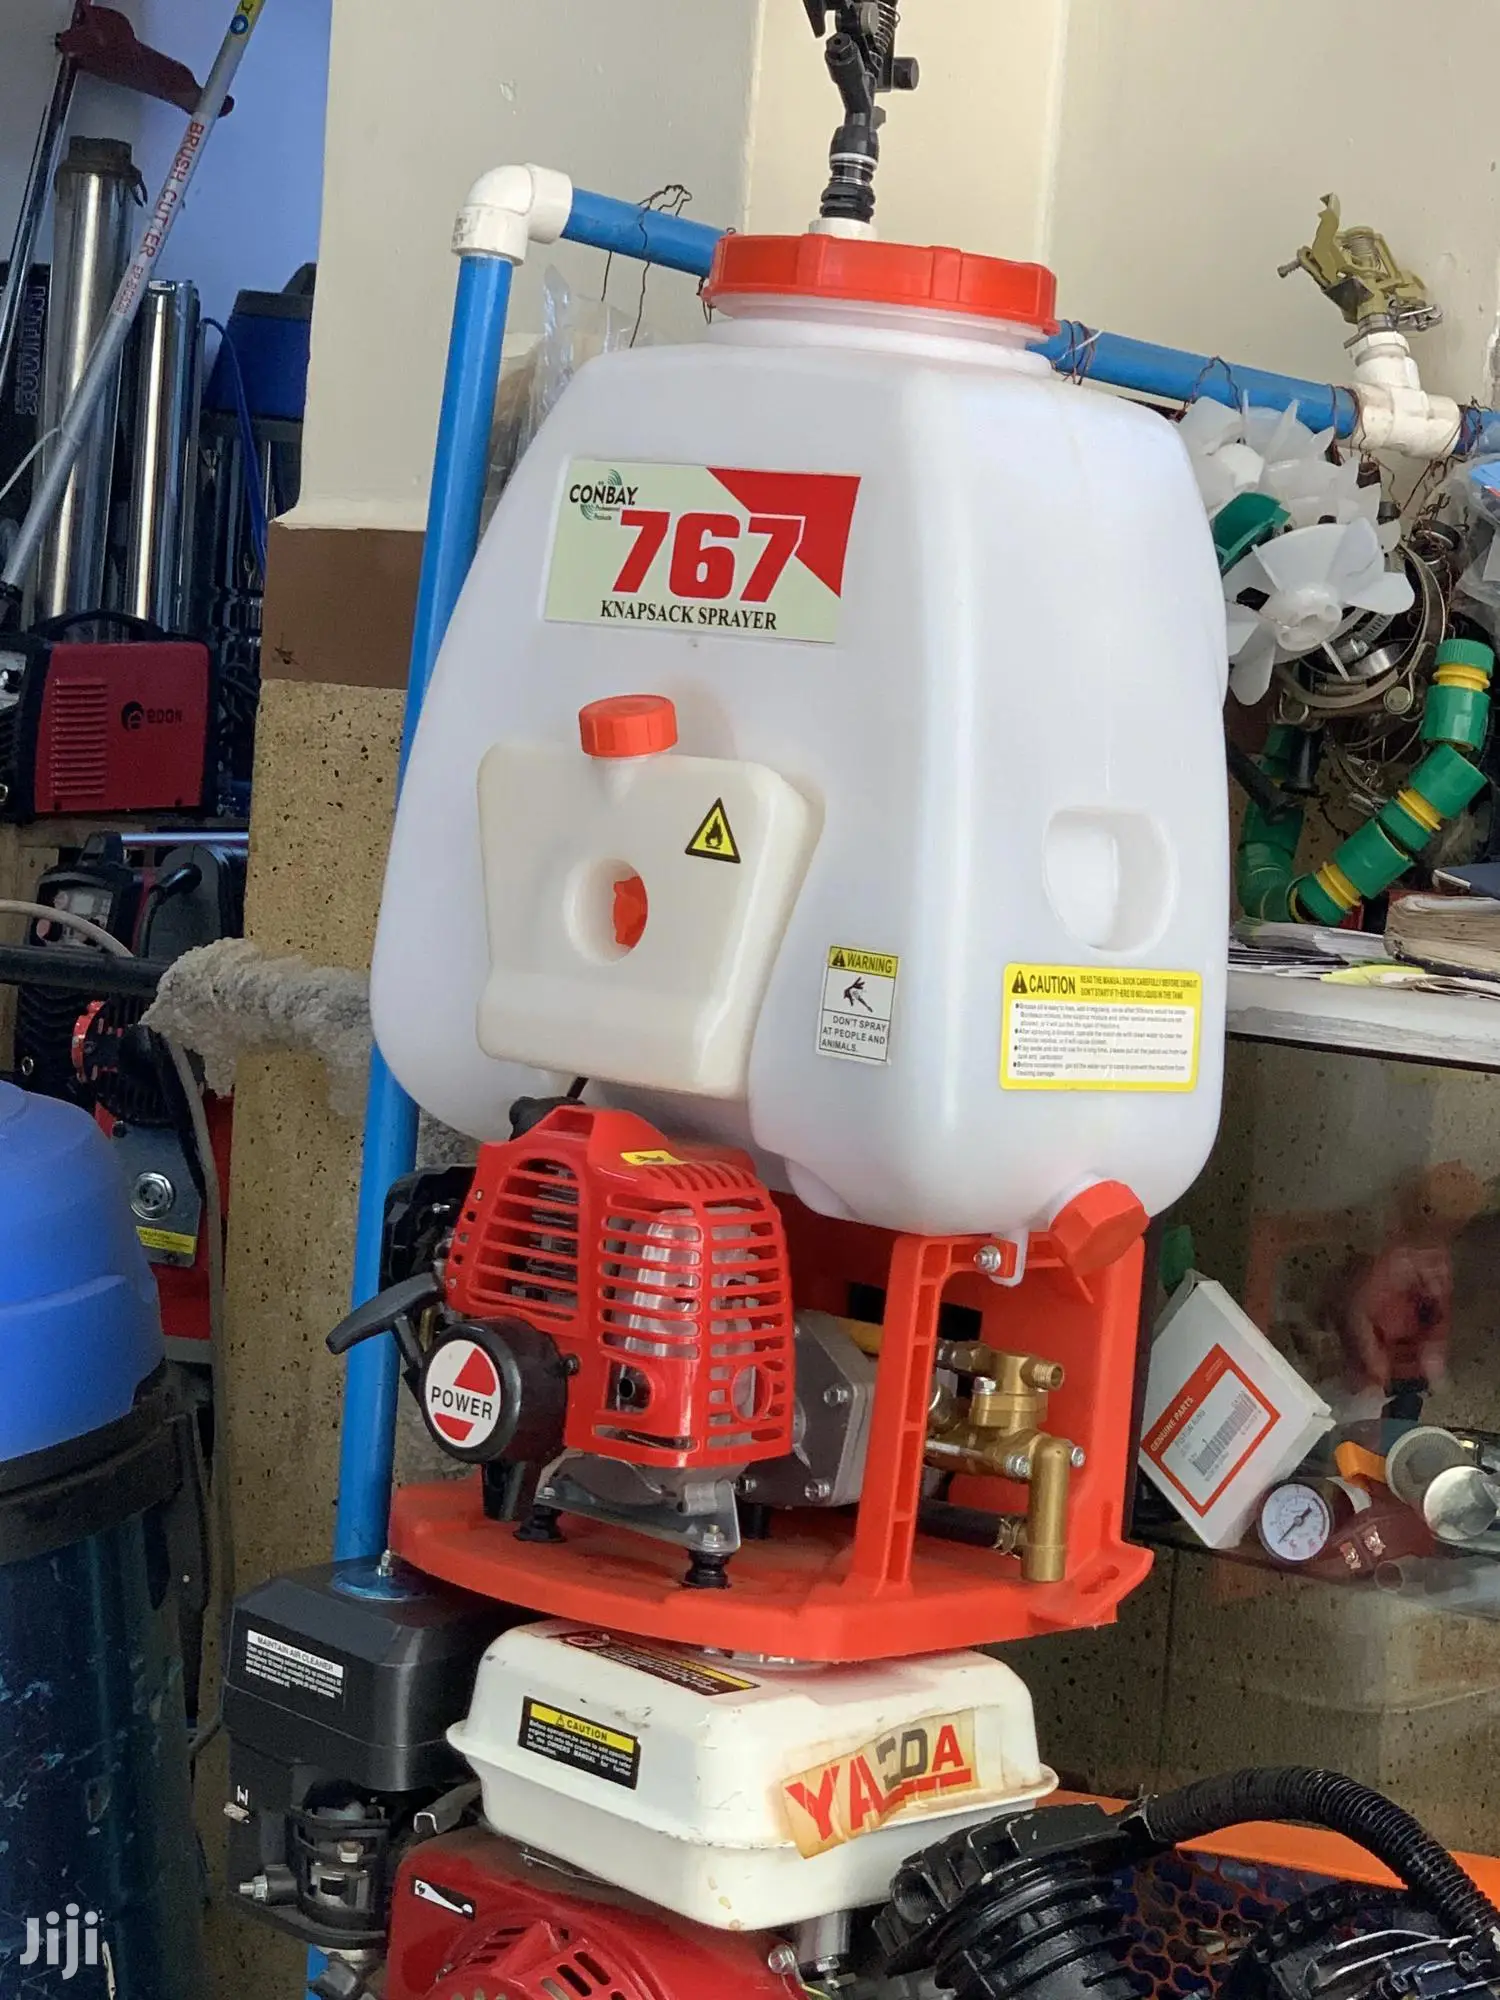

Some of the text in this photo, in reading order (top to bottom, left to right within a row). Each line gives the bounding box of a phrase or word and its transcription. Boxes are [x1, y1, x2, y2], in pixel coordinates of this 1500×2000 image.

[171, 121, 205, 183] BRUSH
[140, 188, 178, 258] CUTTER
[612, 509, 803, 603] 767
[600, 600, 777, 630] KNAPSACK SPRAYER
[847, 952, 892, 973] WARNING
[1029, 975, 1076, 994] CAUTION
[822, 1026, 886, 1045] AT PEOPLE AND
[832, 1015, 886, 1032] DON'T SPRAY
[431, 1386, 492, 1420] POWER
[1150, 1418, 1176, 1452] GENUINE
[1174, 1395, 1194, 1421] PARTS
[257, 1636, 334, 1671] MAINTAIN AIR CLEANER
[566, 1720, 608, 1741] CAUTION
